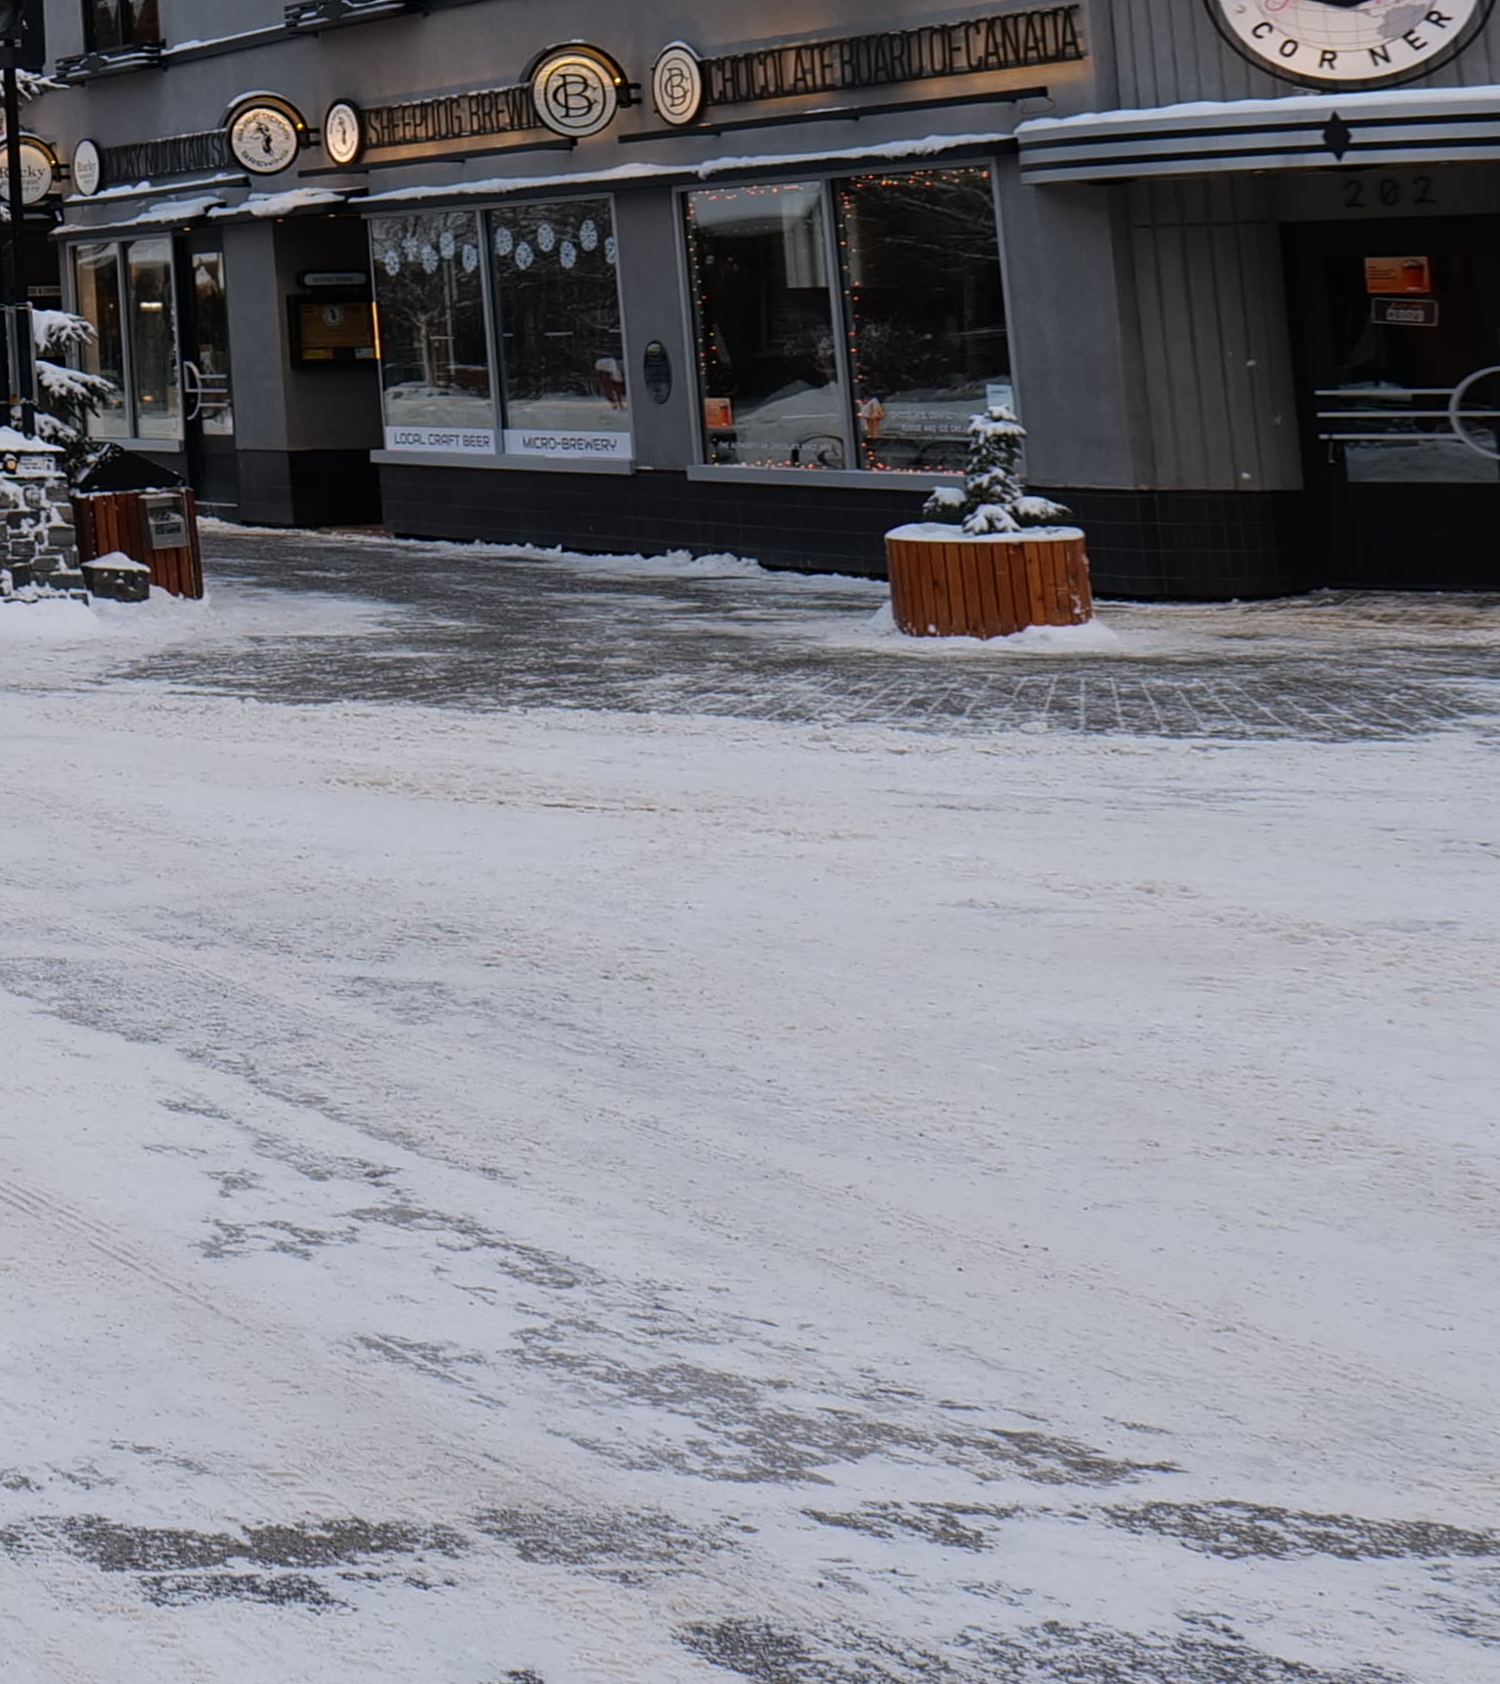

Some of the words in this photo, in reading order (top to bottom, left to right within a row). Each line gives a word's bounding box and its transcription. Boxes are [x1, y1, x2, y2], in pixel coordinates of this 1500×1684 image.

[710, 45, 834, 103] CHOCOLATE
[839, 29, 924, 86] BOARD
[929, 22, 965, 74] OF
[965, 6, 1083, 68] CANADA
[1252, 9, 1453, 70] CORNER
[367, 95, 462, 147] SHEEPDOG
[467, 84, 544, 136] BREWIN
[1344, 175, 1437, 209] 202
[394, 433, 426, 446] LOCAL
[428, 433, 460, 447] CRAFT
[462, 435, 491, 448] BEER
[522, 436, 617, 452] MICRO-BREWERY
